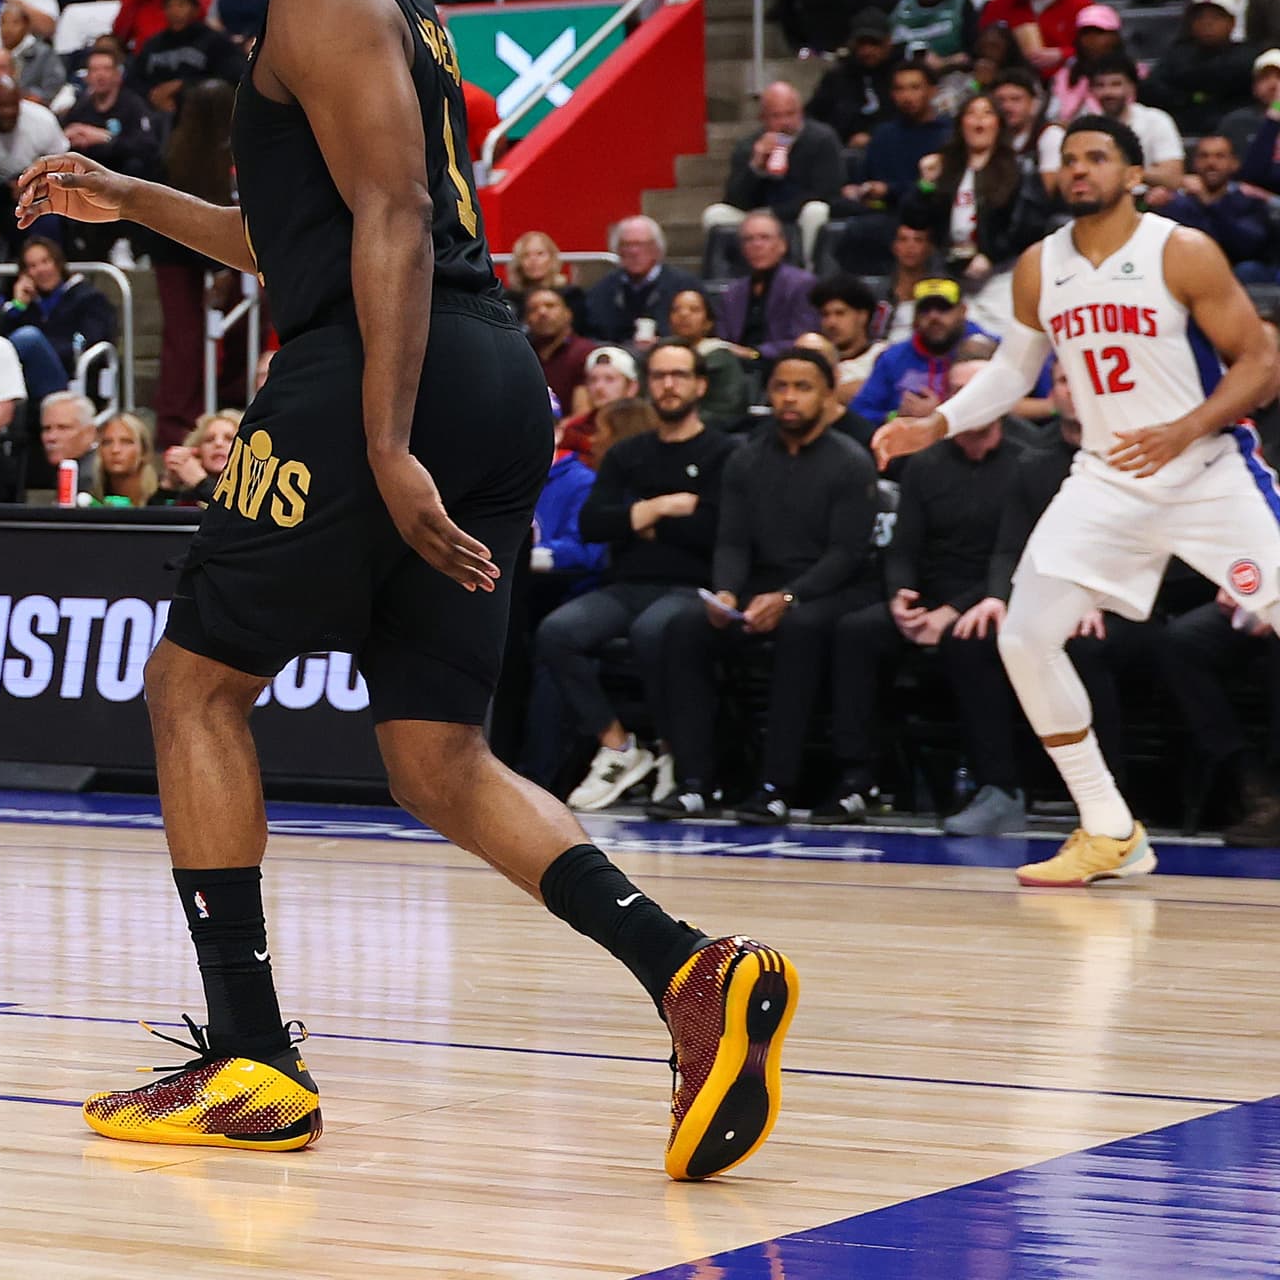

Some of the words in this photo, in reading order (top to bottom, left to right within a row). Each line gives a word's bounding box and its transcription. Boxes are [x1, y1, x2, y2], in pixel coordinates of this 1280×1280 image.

[1049, 303, 1158, 346] PISTONS
[1082, 346, 1136, 395] 12
[197, 429, 312, 528] AVS
